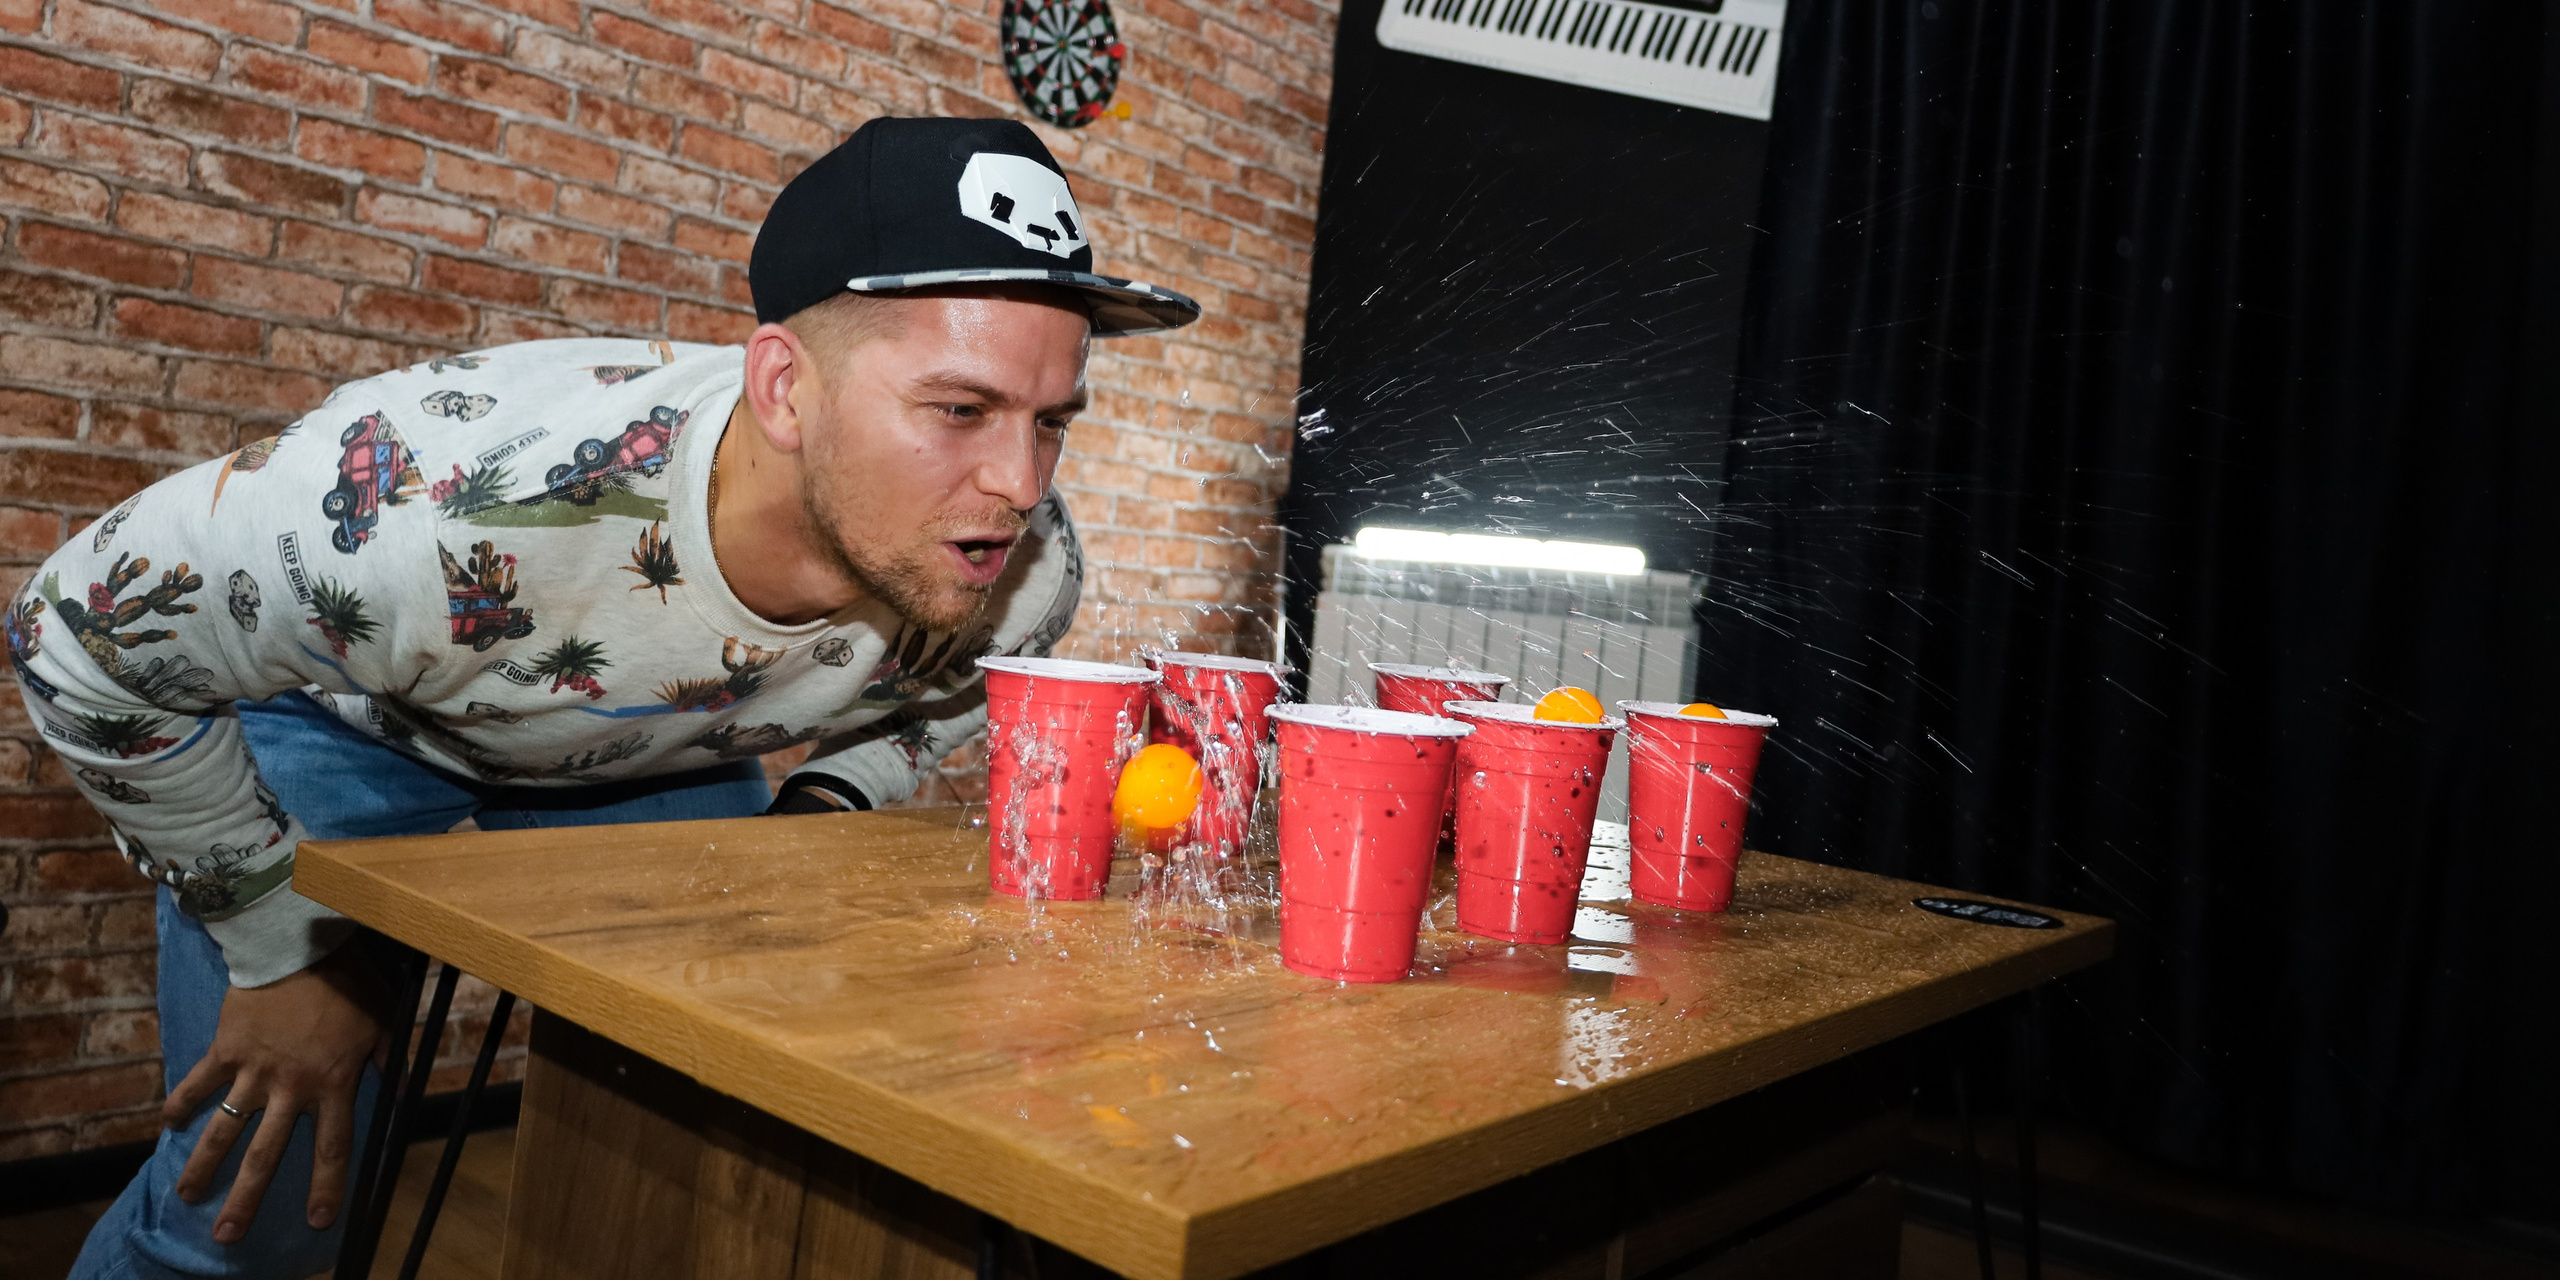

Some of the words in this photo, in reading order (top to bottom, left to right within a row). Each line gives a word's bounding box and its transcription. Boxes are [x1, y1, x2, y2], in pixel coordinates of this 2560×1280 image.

[519, 431, 543, 448] KEEP
[483, 444, 517, 467] GOING
[282, 536, 298, 565] KEEP
[289, 567, 312, 600] GOING
[506, 666, 540, 683] GOING
[68, 733, 98, 751] GOING
